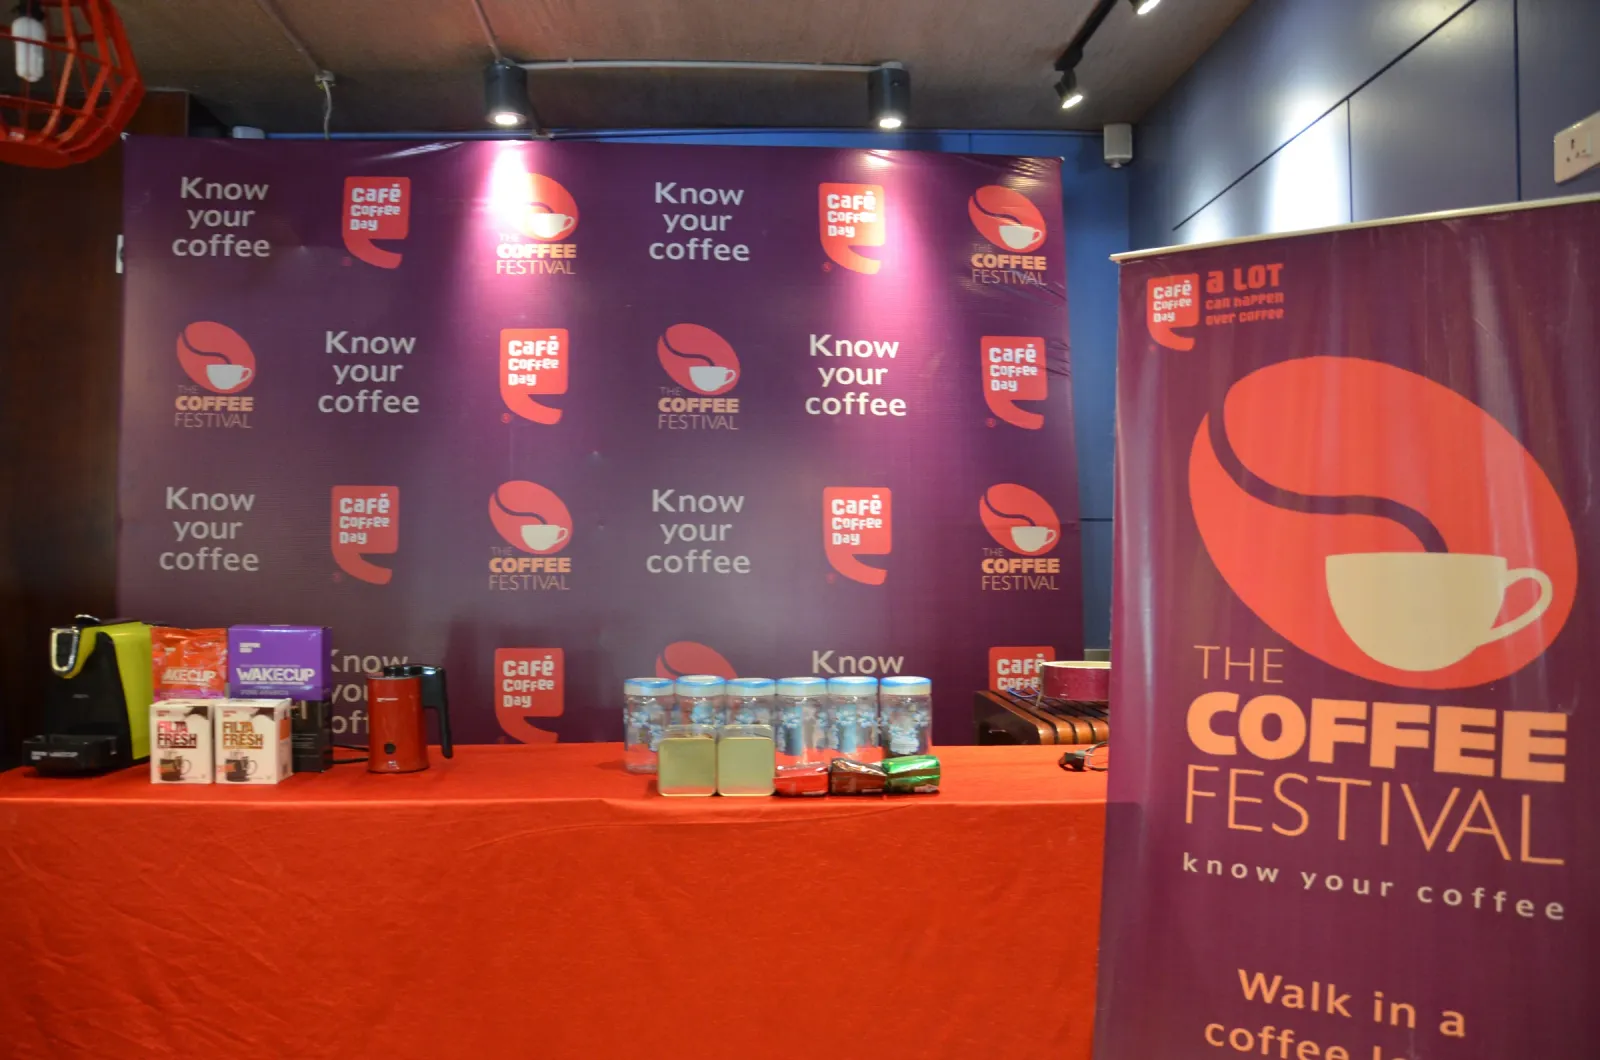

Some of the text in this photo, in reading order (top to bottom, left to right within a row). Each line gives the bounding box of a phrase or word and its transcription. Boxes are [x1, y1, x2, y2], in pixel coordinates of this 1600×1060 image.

[180, 176, 269, 201] Know
[654, 182, 745, 206] Know
[187, 206, 255, 229] your
[350, 218, 378, 232] Day
[662, 211, 732, 233] your
[827, 225, 855, 238] Day
[172, 233, 271, 258] coffee
[496, 243, 577, 258] COFFEE
[649, 238, 750, 262] coffee
[496, 260, 577, 275] FESTIVAL
[971, 254, 1046, 270] COFFEE
[972, 270, 1046, 285] FESTIVAL
[1233, 263, 1284, 291] LOT
[1205, 299, 1230, 310] can
[1205, 314, 1236, 326] over
[325, 330, 416, 355] Know
[809, 334, 899, 358] Know
[332, 363, 404, 386] your
[508, 372, 537, 387] Day
[818, 366, 888, 388] your
[990, 379, 1018, 392] Day
[175, 396, 253, 412] COFFEE
[318, 389, 420, 414] coffee
[658, 398, 740, 413] COFFEE
[805, 393, 907, 417] coffee
[174, 412, 252, 429] FESTIVAL
[658, 414, 739, 430] FESTIVAL
[165, 486, 255, 511] Know
[651, 488, 745, 513] Know
[173, 520, 242, 542] your
[340, 530, 367, 545] Day
[660, 522, 732, 544] your
[832, 532, 860, 546] Day
[159, 547, 260, 572] coffee
[489, 557, 572, 573] COFFEE
[646, 549, 751, 574] coffee
[981, 558, 1060, 574] COFFEE
[489, 574, 570, 591] FESTIVAL
[981, 575, 1059, 591] FESTIVAL
[811, 650, 904, 674] Know
[1193, 645, 1284, 684] THE
[236, 667, 316, 682] WAKECUP
[503, 694, 532, 708] Day
[157, 734, 197, 746] FRESH
[222, 734, 264, 746] FRESH
[1186, 691, 1568, 783] COFFEE
[1185, 764, 1565, 866] FESTIVAL
[1183, 852, 1565, 920] know your coffee
[1238, 968, 1466, 1038] Walk in a
[1204, 1023, 1349, 1060] coffee
